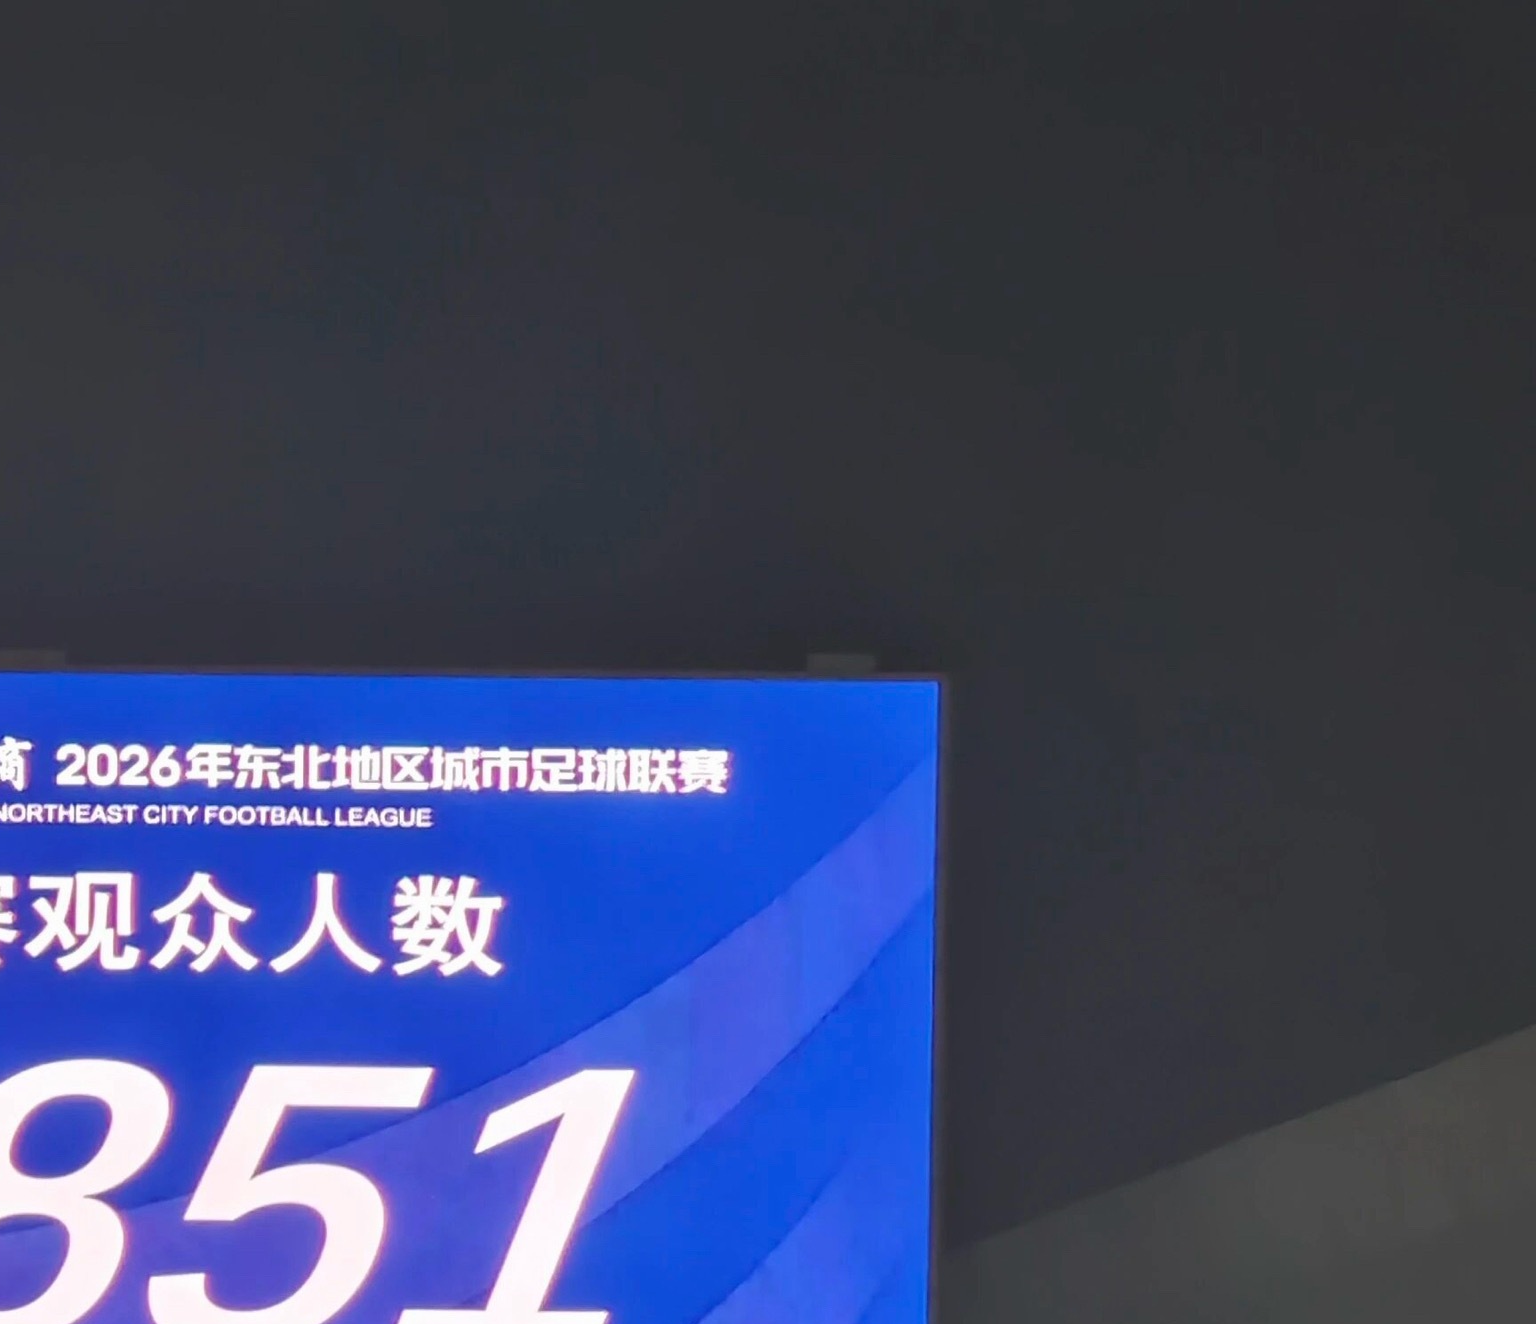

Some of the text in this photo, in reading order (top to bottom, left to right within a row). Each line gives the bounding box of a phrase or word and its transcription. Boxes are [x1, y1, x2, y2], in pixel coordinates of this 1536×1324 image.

[55, 743, 731, 794] 2026年东北地区城市足球联赛
[143, 805, 199, 826] CITY
[204, 805, 330, 828] FOOTBALL
[335, 806, 433, 828] LEAGUE
